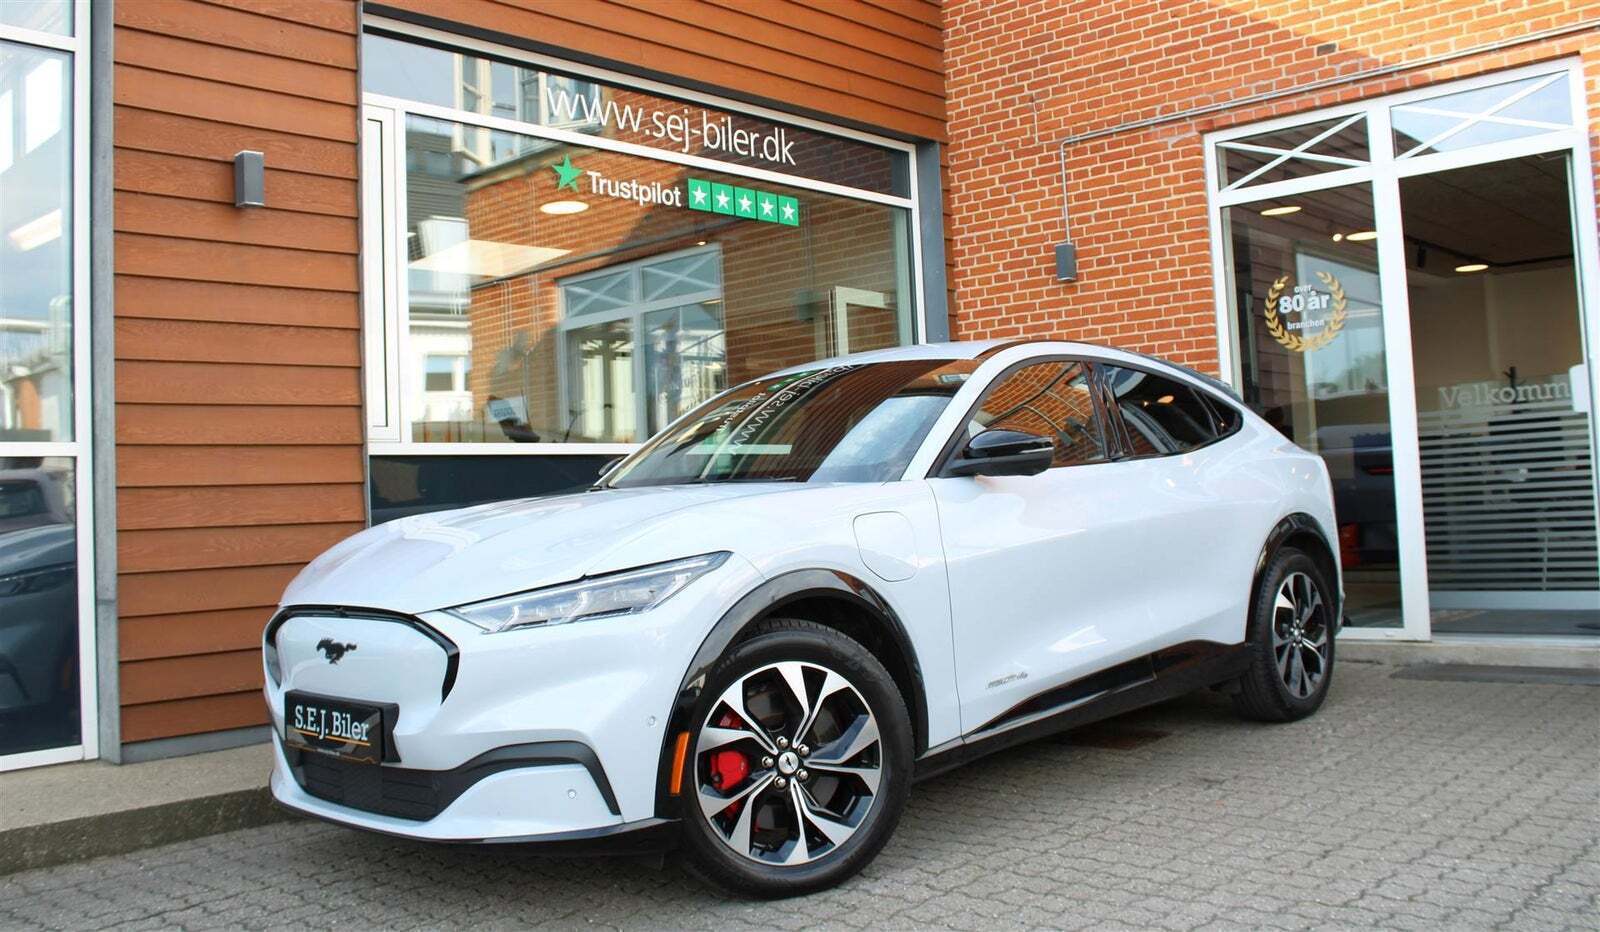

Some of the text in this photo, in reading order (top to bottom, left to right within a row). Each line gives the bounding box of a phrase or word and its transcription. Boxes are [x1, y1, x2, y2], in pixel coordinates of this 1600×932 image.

[547, 86, 796, 166] www.sej-biler.dk
[587, 170, 681, 208] Trustpilot
[1279, 290, 1330, 314] 80 år
[1294, 284, 1312, 293] over
[1438, 381, 1570, 408] Velkomm
[295, 704, 369, 741] S.E.J. Biler
